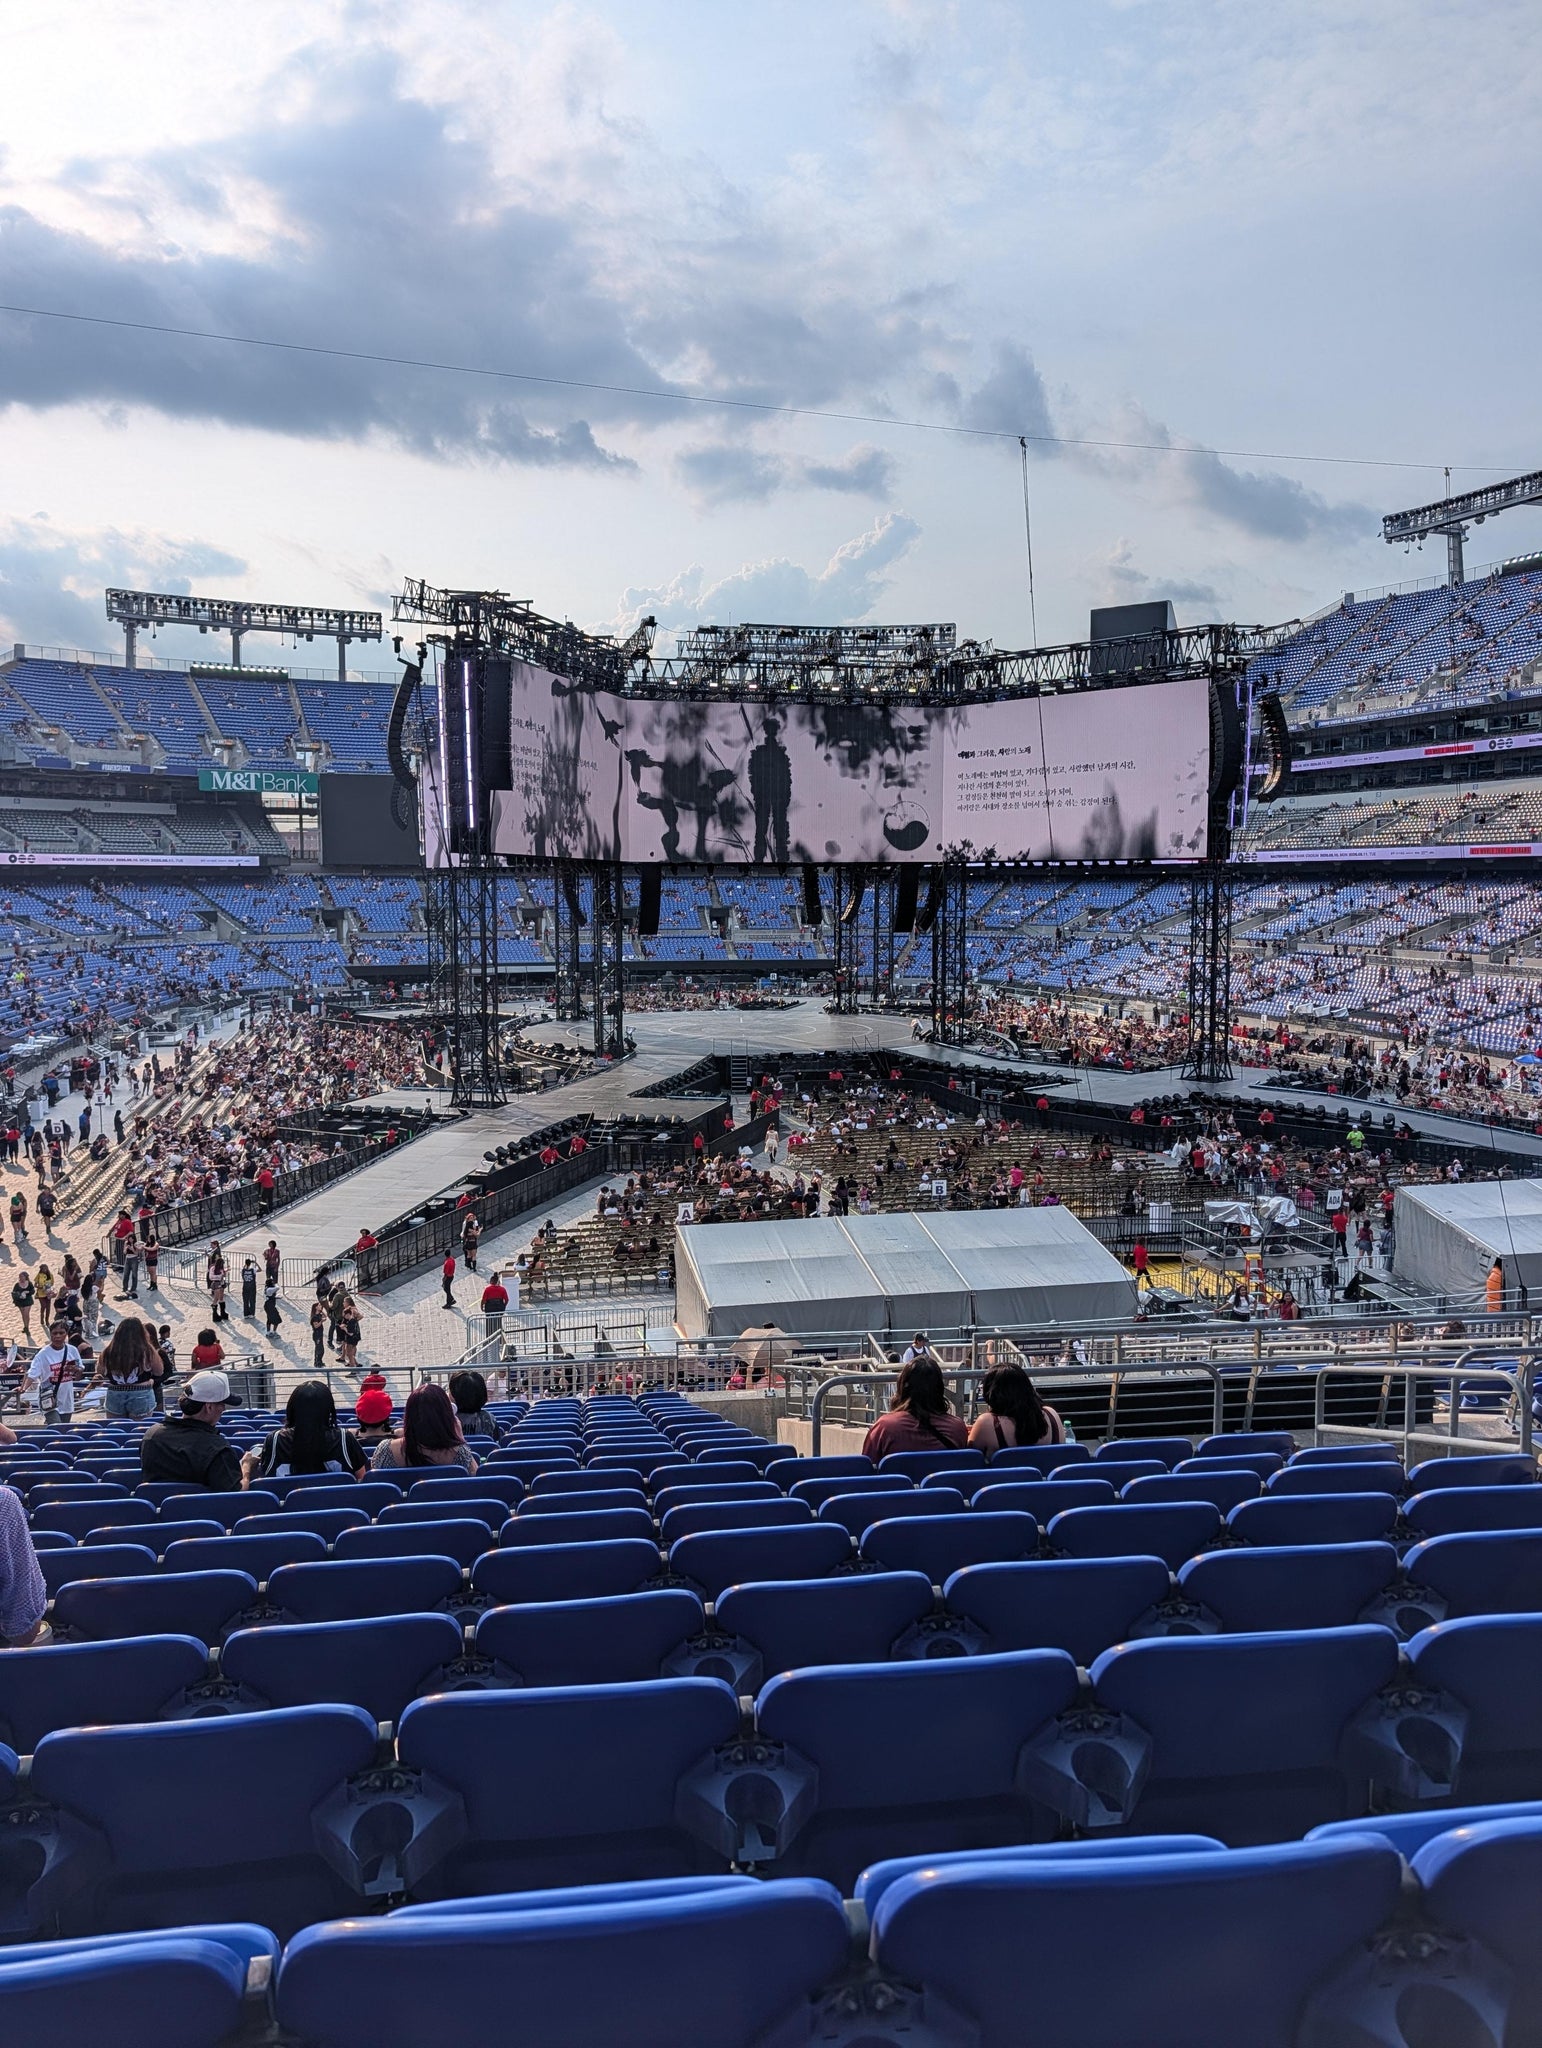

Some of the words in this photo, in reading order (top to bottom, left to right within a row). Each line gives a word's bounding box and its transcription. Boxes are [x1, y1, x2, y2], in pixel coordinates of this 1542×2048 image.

[211, 771, 260, 790] M&T
[262, 773, 307, 792] Bank
[936, 1186, 944, 1194] B
[1329, 1196, 1340, 1204] ADA
[682, 1210, 690, 1219] A
